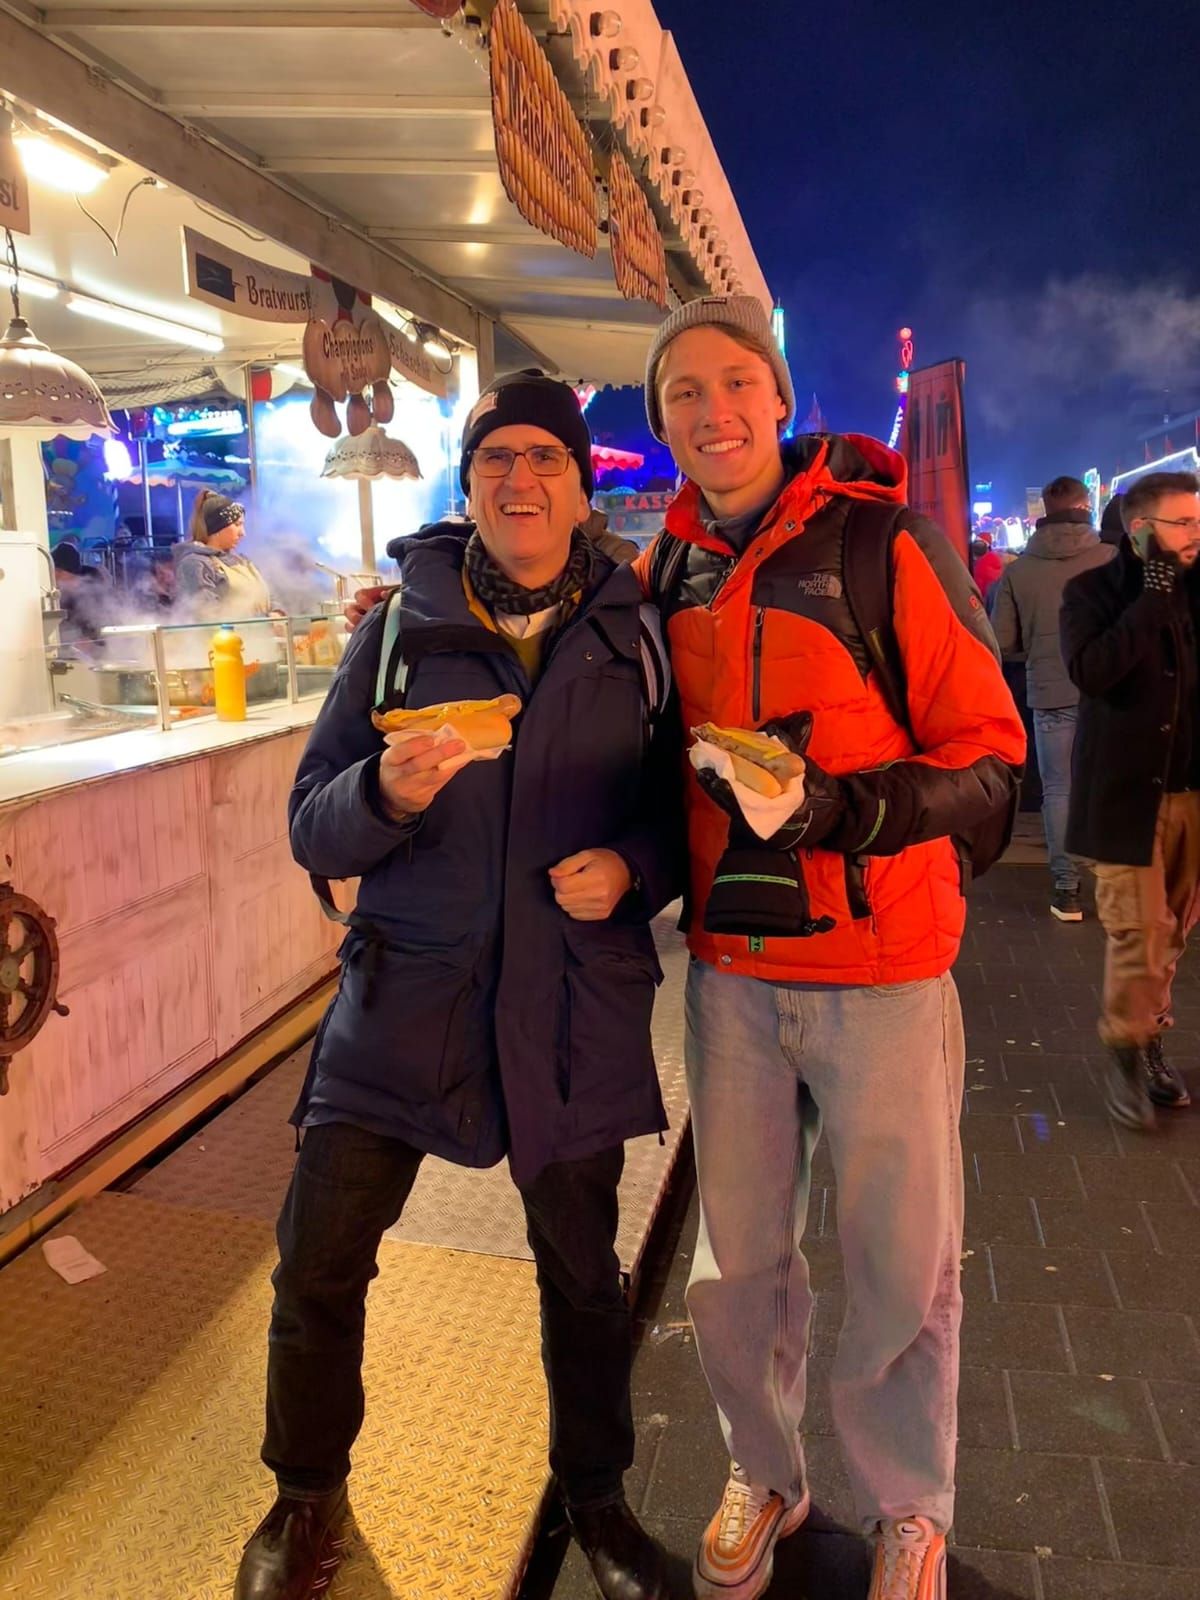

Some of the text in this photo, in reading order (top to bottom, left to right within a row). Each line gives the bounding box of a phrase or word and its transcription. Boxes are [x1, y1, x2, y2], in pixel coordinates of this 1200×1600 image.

[507, 53, 577, 201] Maiskolben
[246, 275, 311, 311] Bratwurst
[323, 331, 374, 362] Champignons
[798, 580, 829, 589] NORTH
[813, 573, 829, 581] THE
[803, 588, 829, 596] FACE
